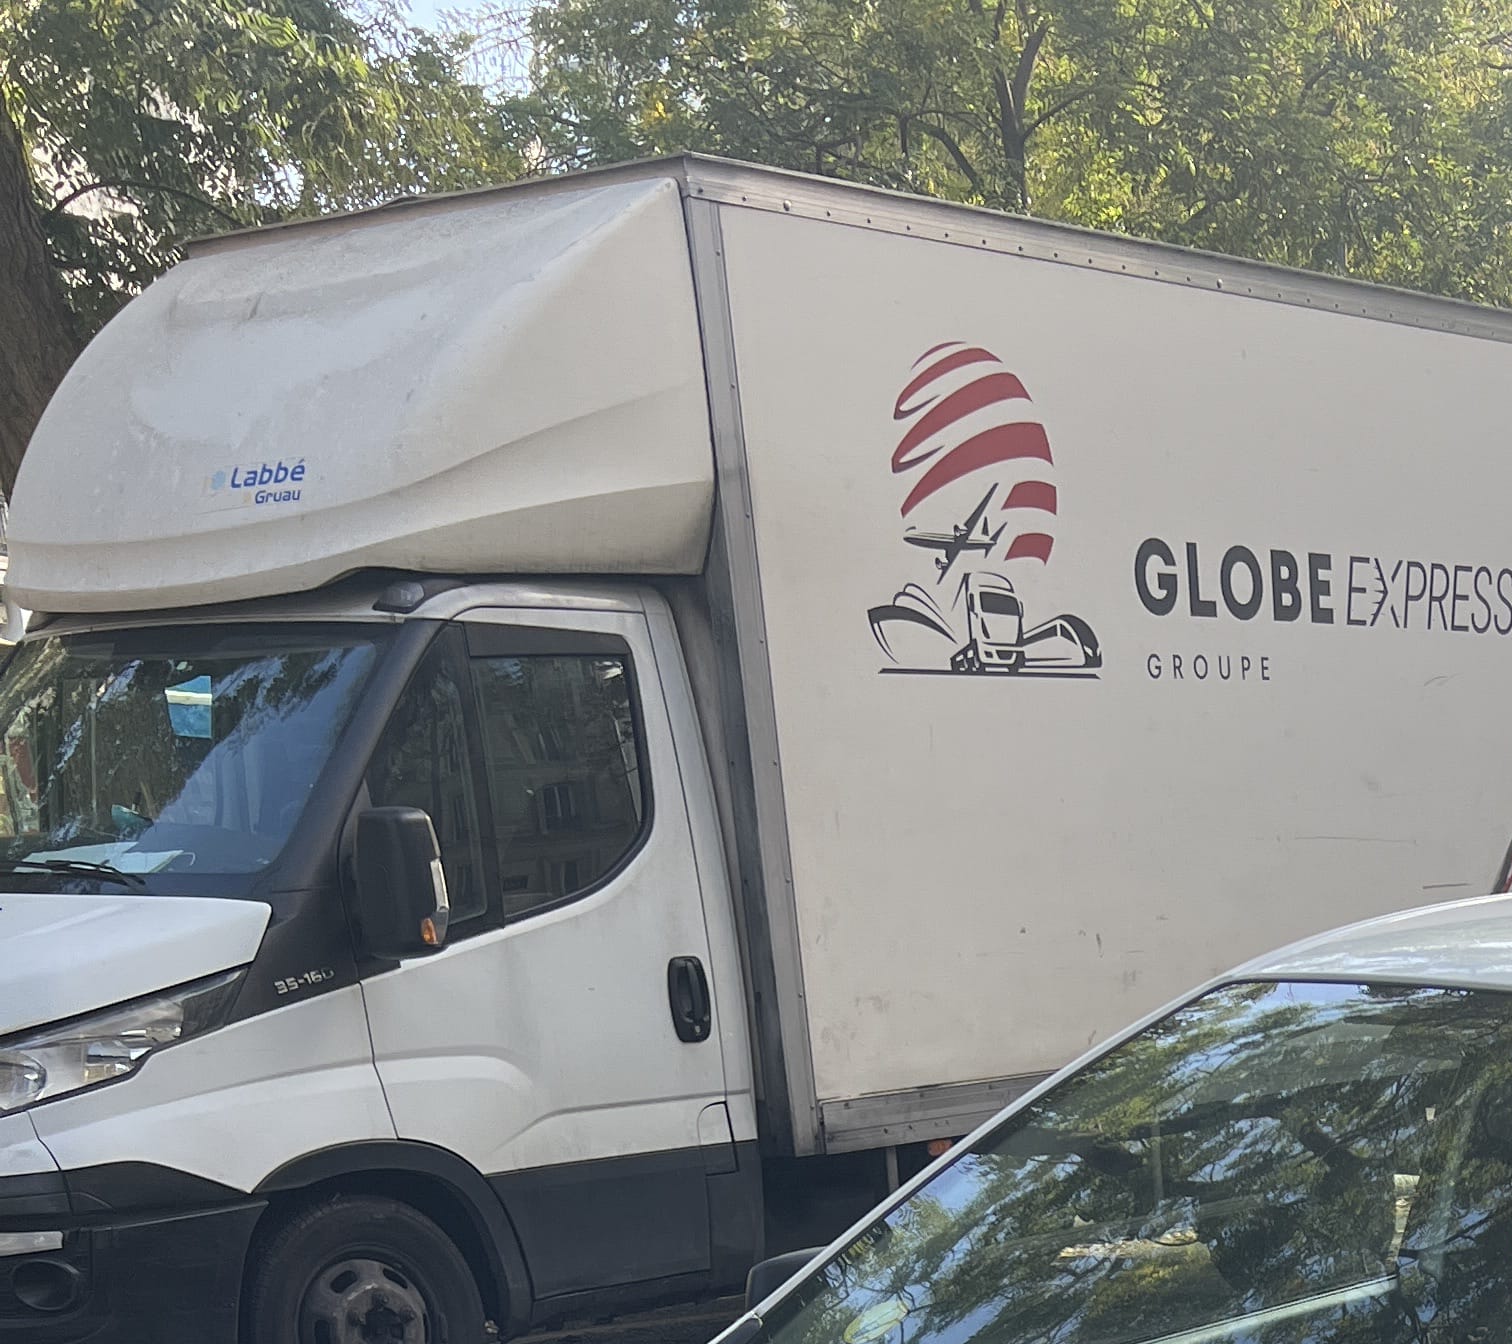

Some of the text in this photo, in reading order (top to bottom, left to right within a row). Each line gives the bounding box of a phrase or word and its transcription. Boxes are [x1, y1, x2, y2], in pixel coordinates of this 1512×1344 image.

[230, 458, 306, 489] Labbé
[254, 489, 302, 505] Gruau
[1134, 537, 1335, 626] GLOBE
[1146, 653, 1271, 682] GROUPE
